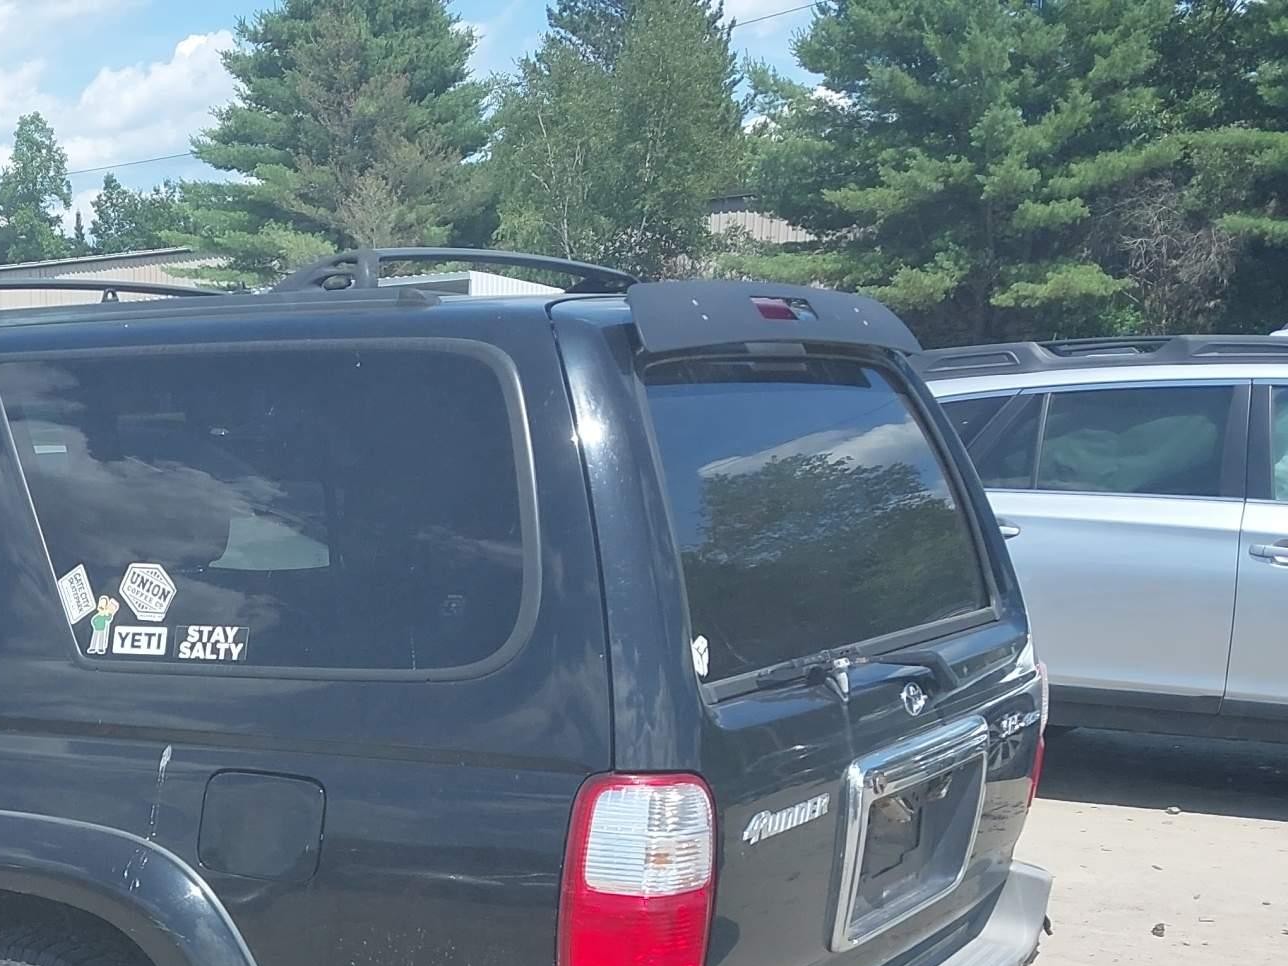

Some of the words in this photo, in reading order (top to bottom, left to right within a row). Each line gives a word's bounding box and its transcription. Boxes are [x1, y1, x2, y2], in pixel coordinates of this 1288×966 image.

[73, 572, 86, 593] GATE
[80, 592, 92, 608] CITY
[127, 585, 154, 605] COFFEE
[130, 571, 171, 602] UNION
[117, 631, 163, 650] YETI
[187, 625, 240, 643] STAY
[178, 641, 244, 660] SALTY
